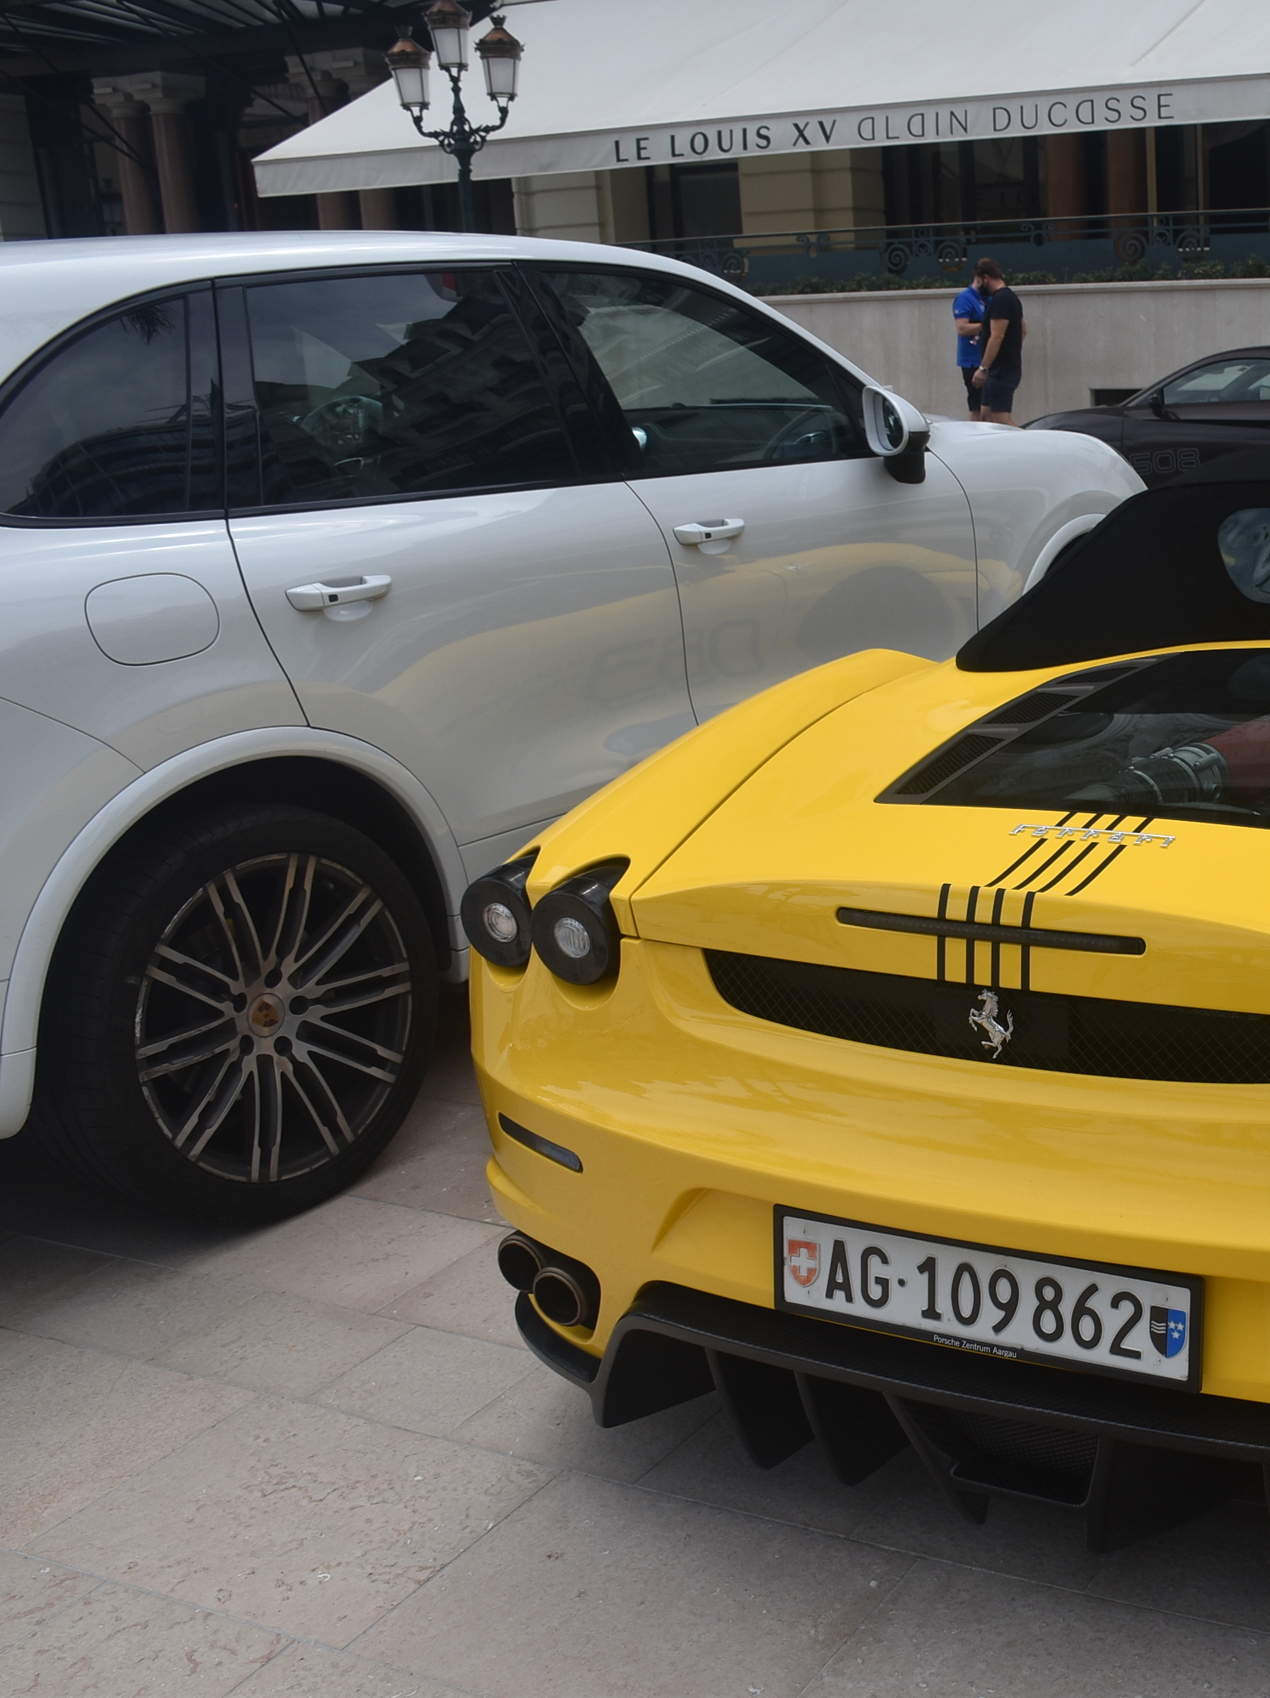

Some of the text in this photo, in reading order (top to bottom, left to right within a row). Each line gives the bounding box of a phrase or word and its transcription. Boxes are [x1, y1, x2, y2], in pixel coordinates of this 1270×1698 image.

[614, 137, 651, 163] LE
[669, 125, 772, 158] LOUIS
[791, 119, 837, 147] XV
[1130, 448, 1201, 475] 508
[1008, 823, 1176, 848] Ferrari
[933, 1334, 1017, 1358] Porsche Zentrum Aargau
